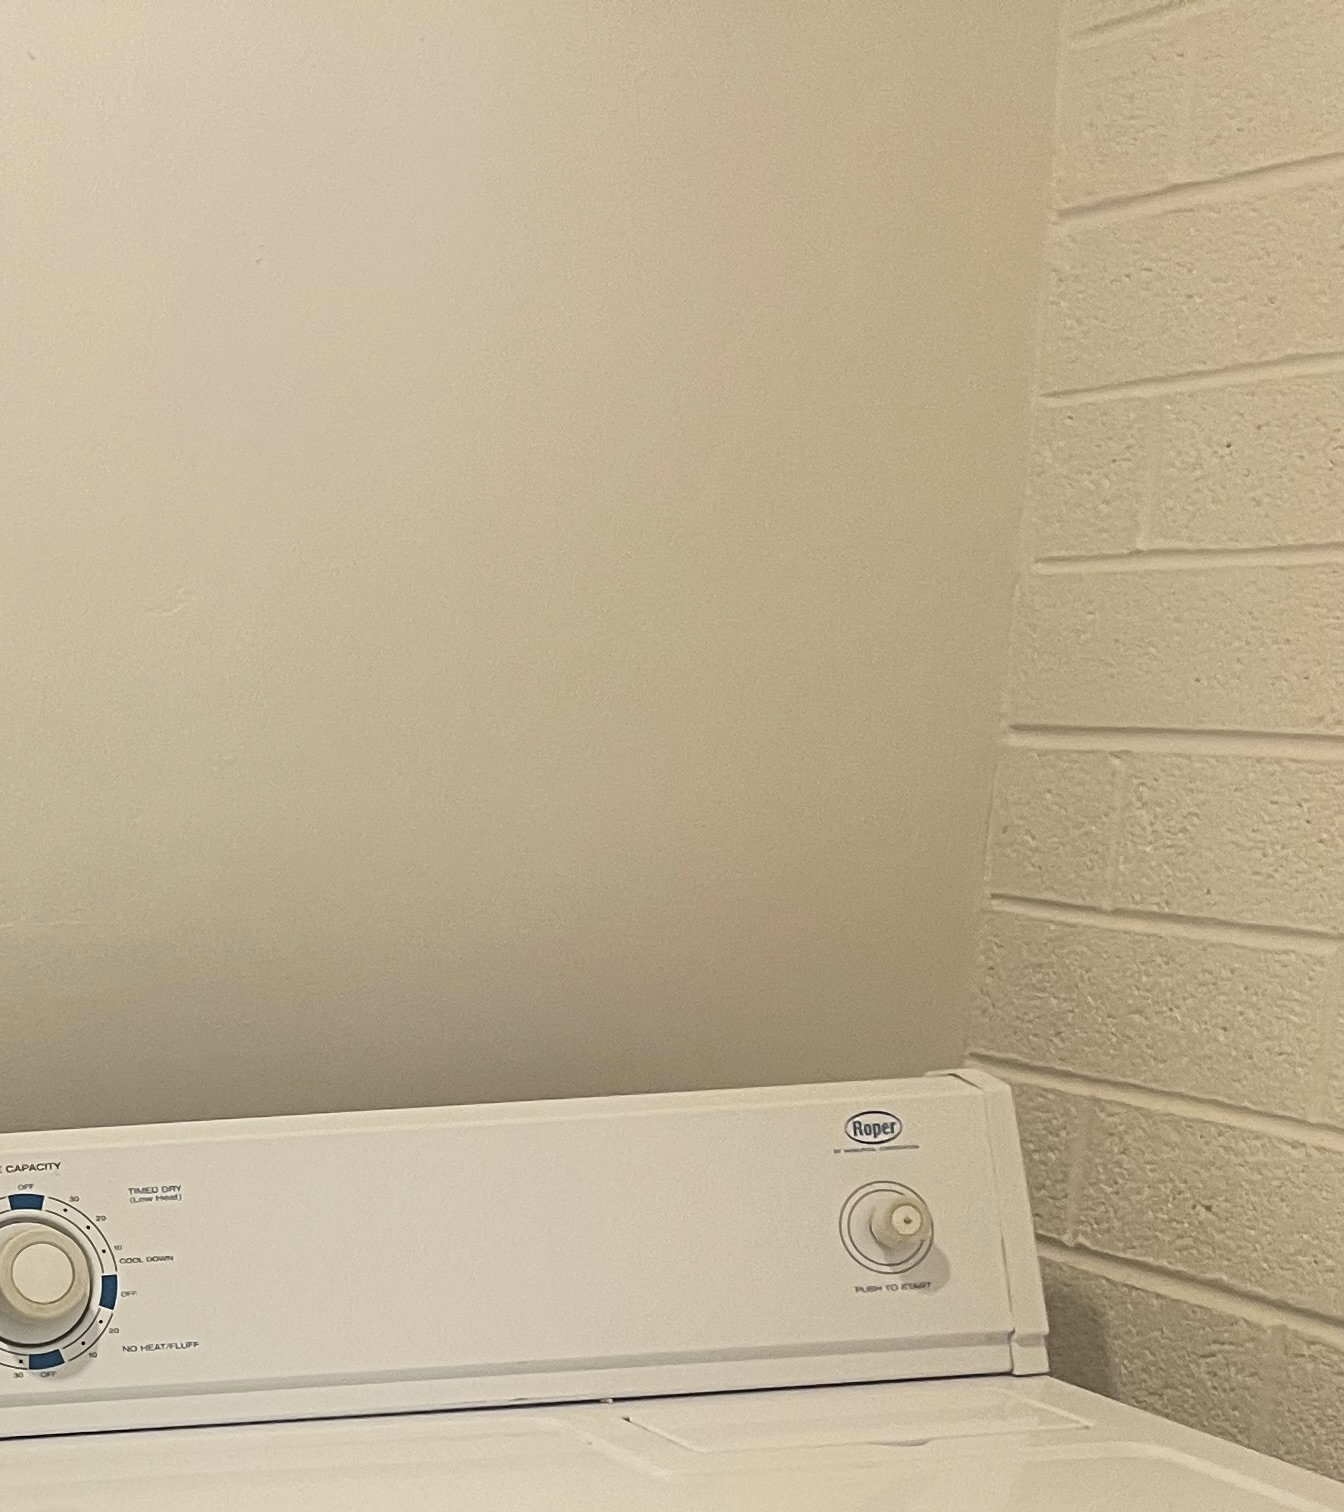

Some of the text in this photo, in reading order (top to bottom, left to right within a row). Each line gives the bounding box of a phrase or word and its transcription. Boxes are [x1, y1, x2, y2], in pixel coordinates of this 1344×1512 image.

[853, 1120, 896, 1138] Roper
[5, 1162, 61, 1173] CAPACITY
[128, 1185, 182, 1195] TIMED DRY
[140, 1341, 199, 1352] HEAT/FLUFF
